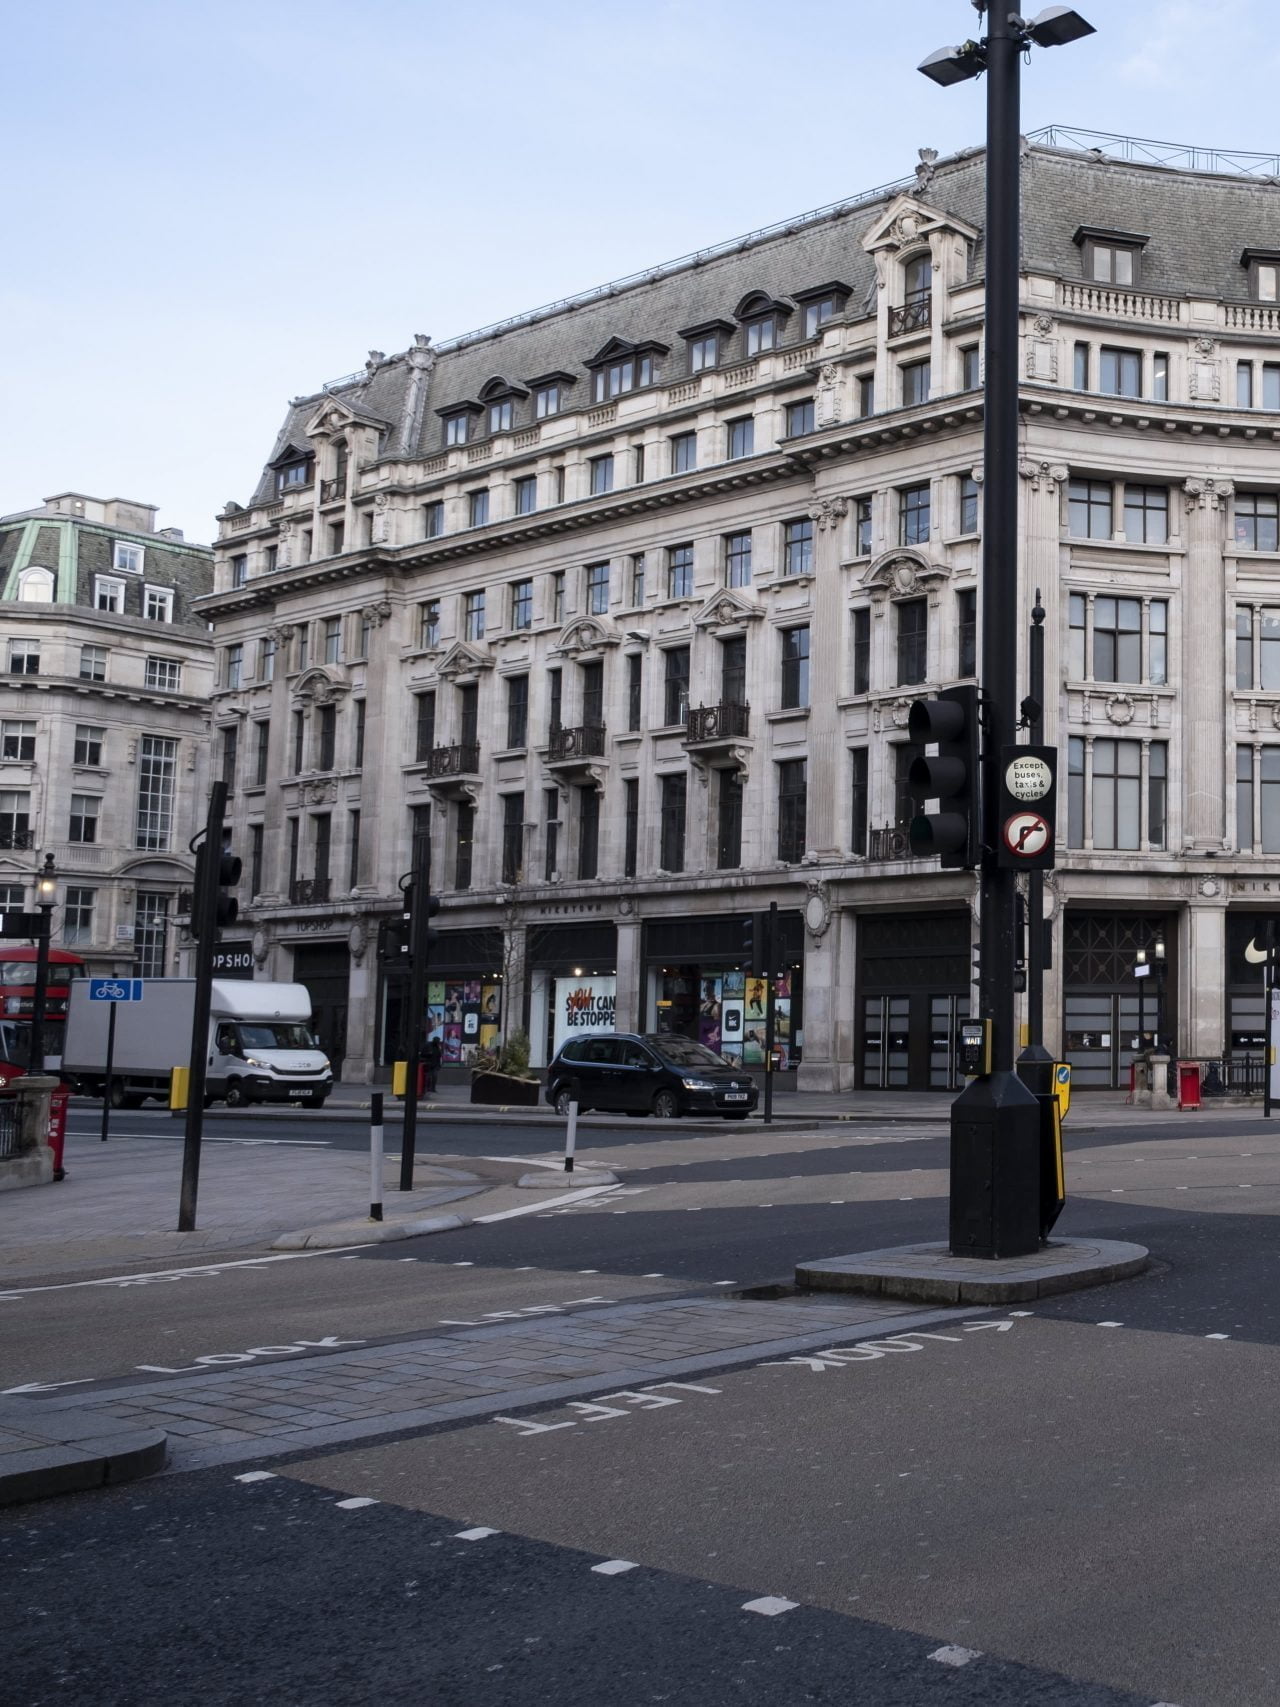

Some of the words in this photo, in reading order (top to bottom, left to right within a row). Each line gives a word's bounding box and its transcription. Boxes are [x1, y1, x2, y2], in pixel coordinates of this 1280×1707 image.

[1013, 762, 1044, 770] Except
[1015, 780, 1037, 788] taxis
[1039, 780, 1045, 788] &
[1015, 790, 1044, 799] cycles
[296, 918, 333, 932] TOPSHOP
[567, 1011, 579, 1026] BE
[134, 1336, 367, 1373] LOOK
[438, 1296, 619, 1325] LEFT
[757, 1332, 963, 1372] LOOK
[494, 1382, 723, 1436] LEFT
